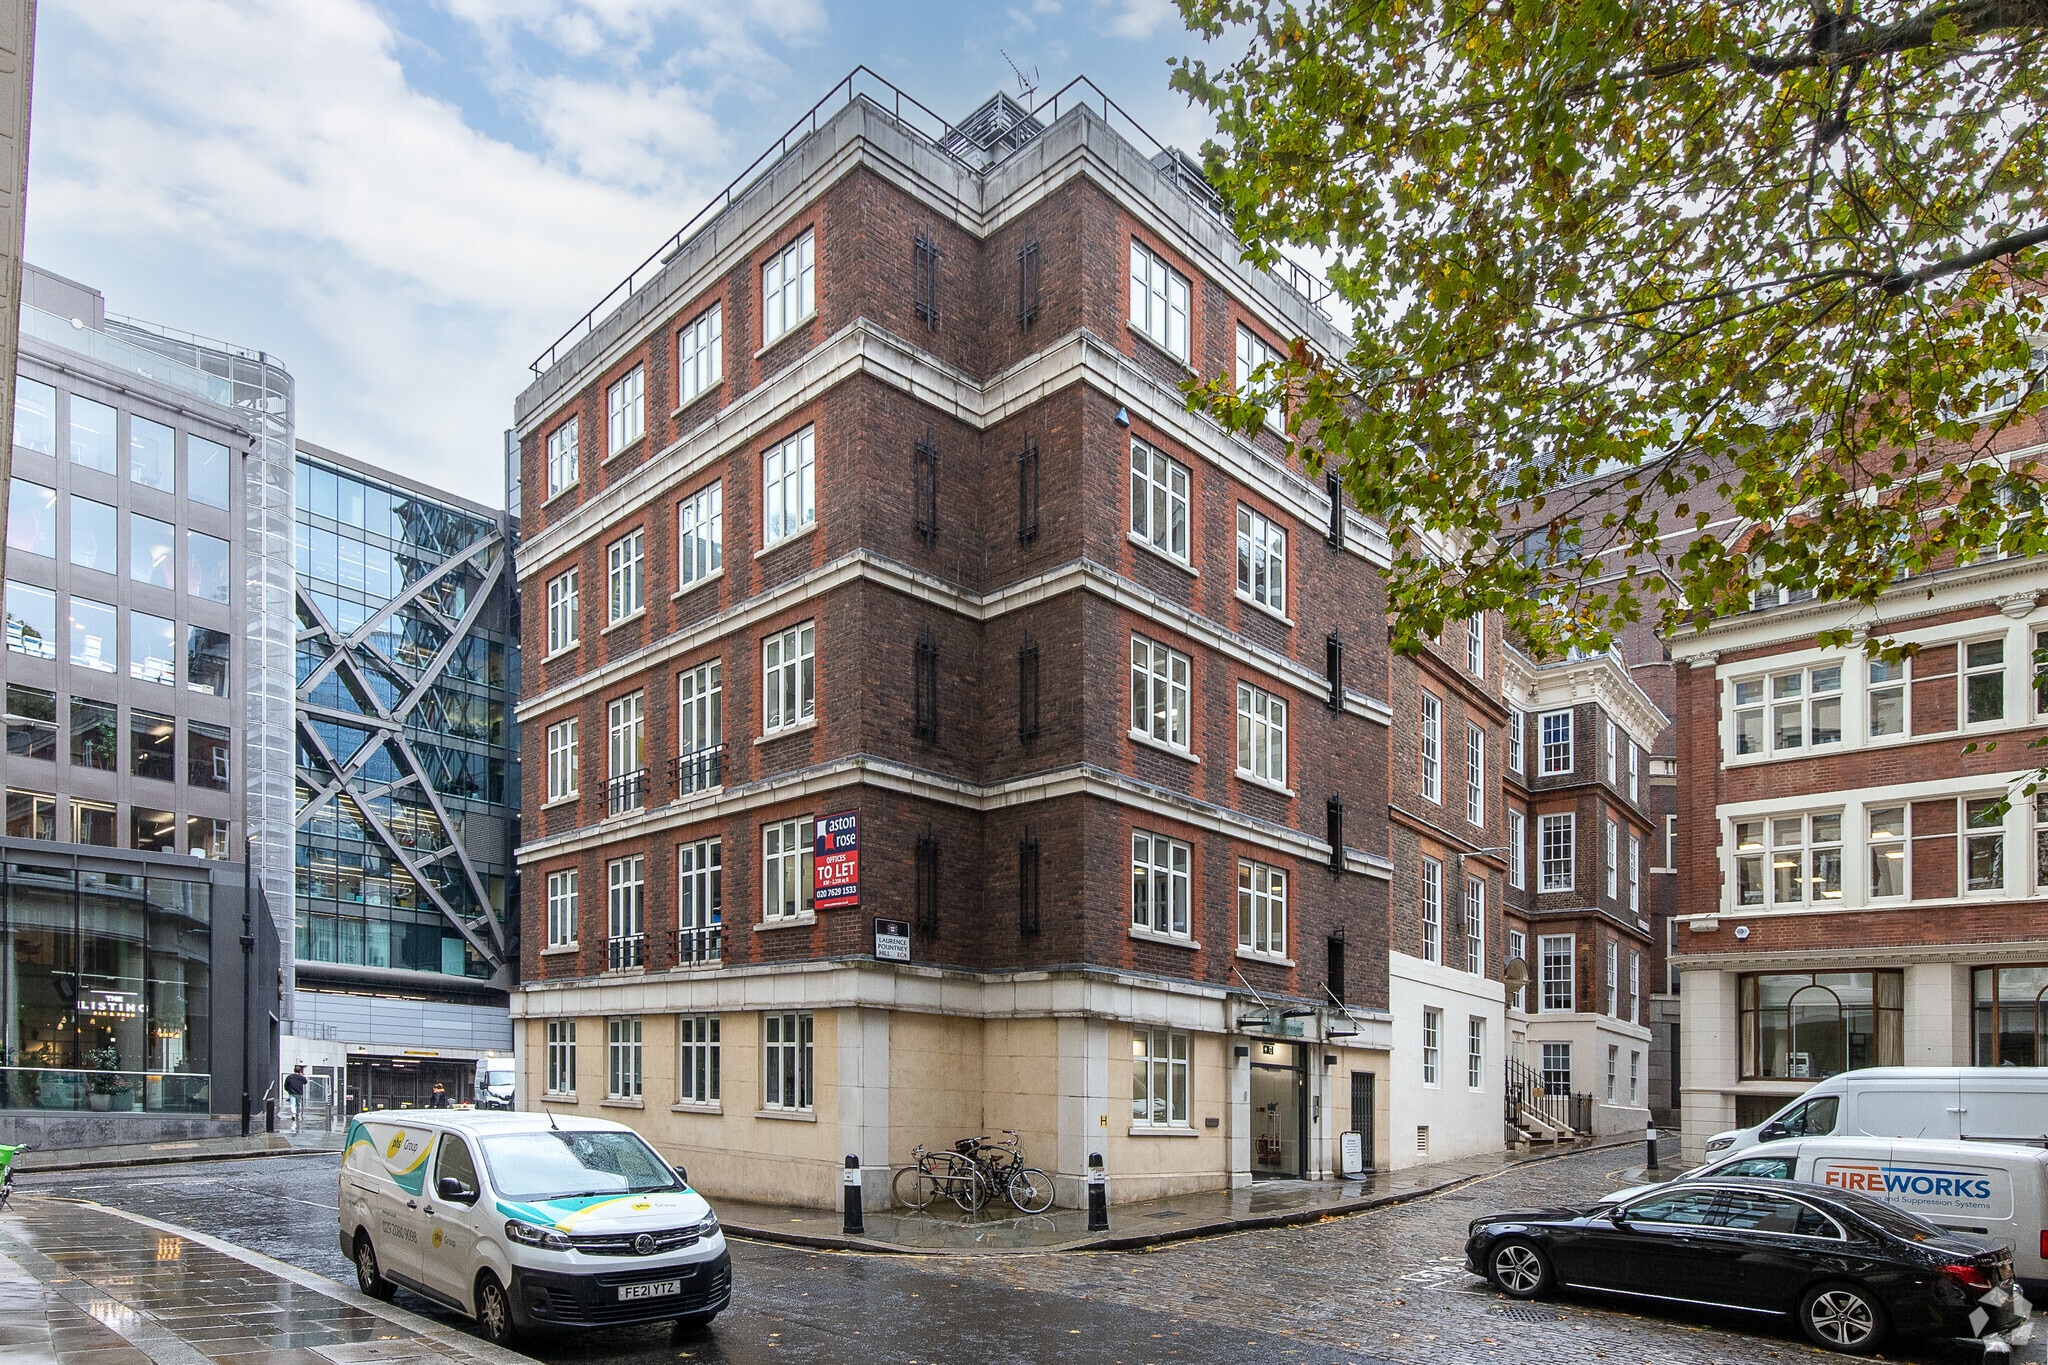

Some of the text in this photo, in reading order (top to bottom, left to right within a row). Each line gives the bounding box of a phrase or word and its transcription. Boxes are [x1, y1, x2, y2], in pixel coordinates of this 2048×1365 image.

[829, 816, 856, 832] aston
[836, 833, 856, 848] rose
[826, 854, 847, 864] OFFICES
[817, 861, 856, 880] TO LET
[816, 885, 857, 898] 020 7629 1533
[878, 944, 908, 952] POUNTNEY
[879, 938, 907, 946] LAURENCE
[1100, 1115, 1107, 1127] H
[391, 1136, 419, 1154] phs Group
[1825, 1171, 1991, 1199] FIREWORKS
[1884, 1195, 1900, 1203] and
[1902, 1196, 1953, 1207] Suppression
[1955, 1200, 1991, 1210] Systems
[434, 1232, 457, 1248] phs Group
[625, 1282, 674, 1299] FE21 YTZ
